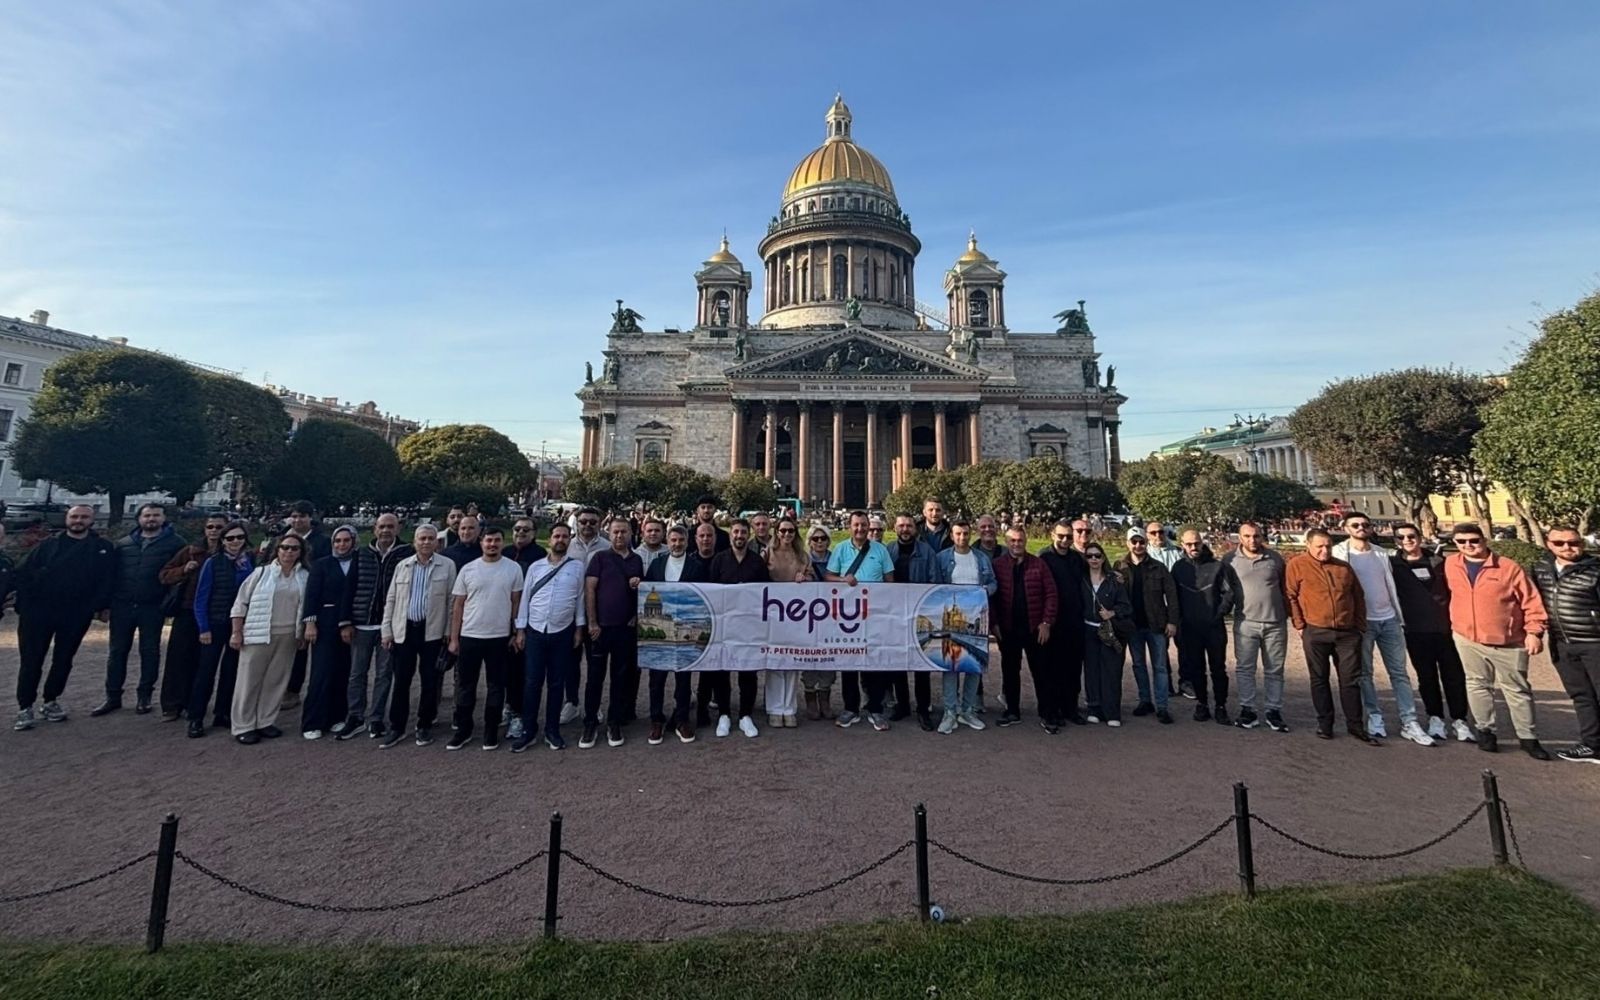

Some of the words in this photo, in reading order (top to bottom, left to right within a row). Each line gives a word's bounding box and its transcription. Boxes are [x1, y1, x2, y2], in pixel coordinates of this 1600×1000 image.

[762, 586, 868, 634] hepiyi
[773, 647, 827, 655] PETERSBURG
[829, 646, 868, 655] SEYAHATİ
